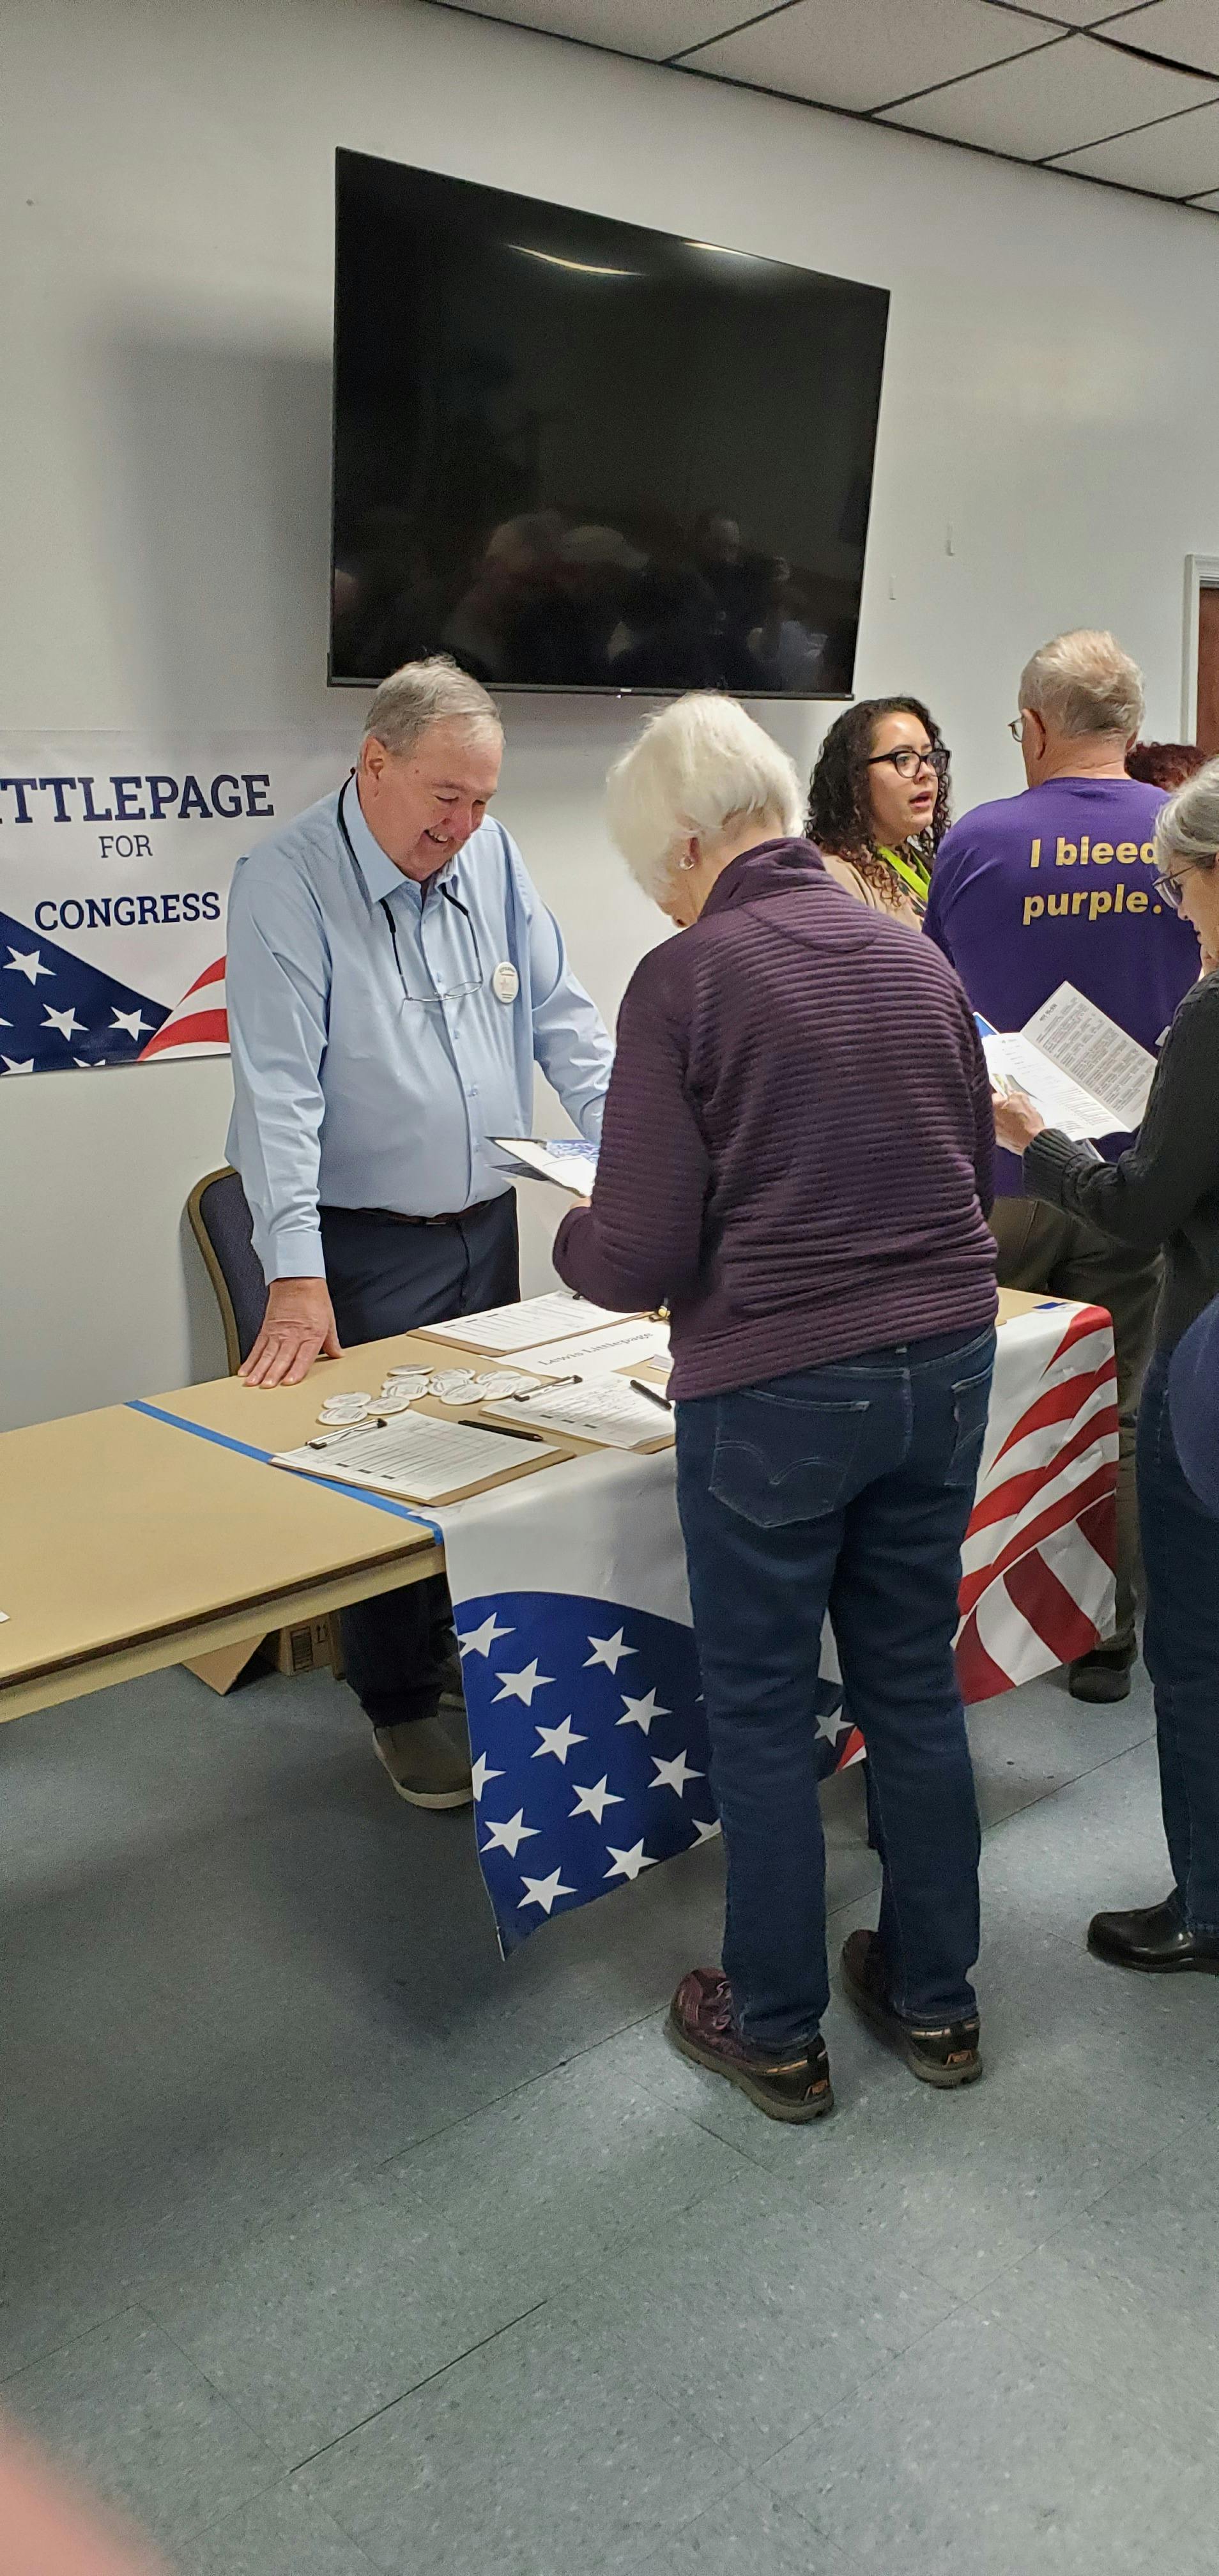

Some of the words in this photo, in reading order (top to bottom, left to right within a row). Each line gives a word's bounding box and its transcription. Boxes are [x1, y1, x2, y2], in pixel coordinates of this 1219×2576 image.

[0, 774, 274, 824] TTLEPAGE
[98, 835, 153, 857] FOR
[1030, 838, 1041, 868] I
[1055, 836, 1159, 866] bleed
[34, 892, 220, 930] CONGRESS
[1023, 884, 1162, 925] purple.
[537, 1352, 584, 1366] Lewis
[582, 1332, 654, 1354] Littlepage
